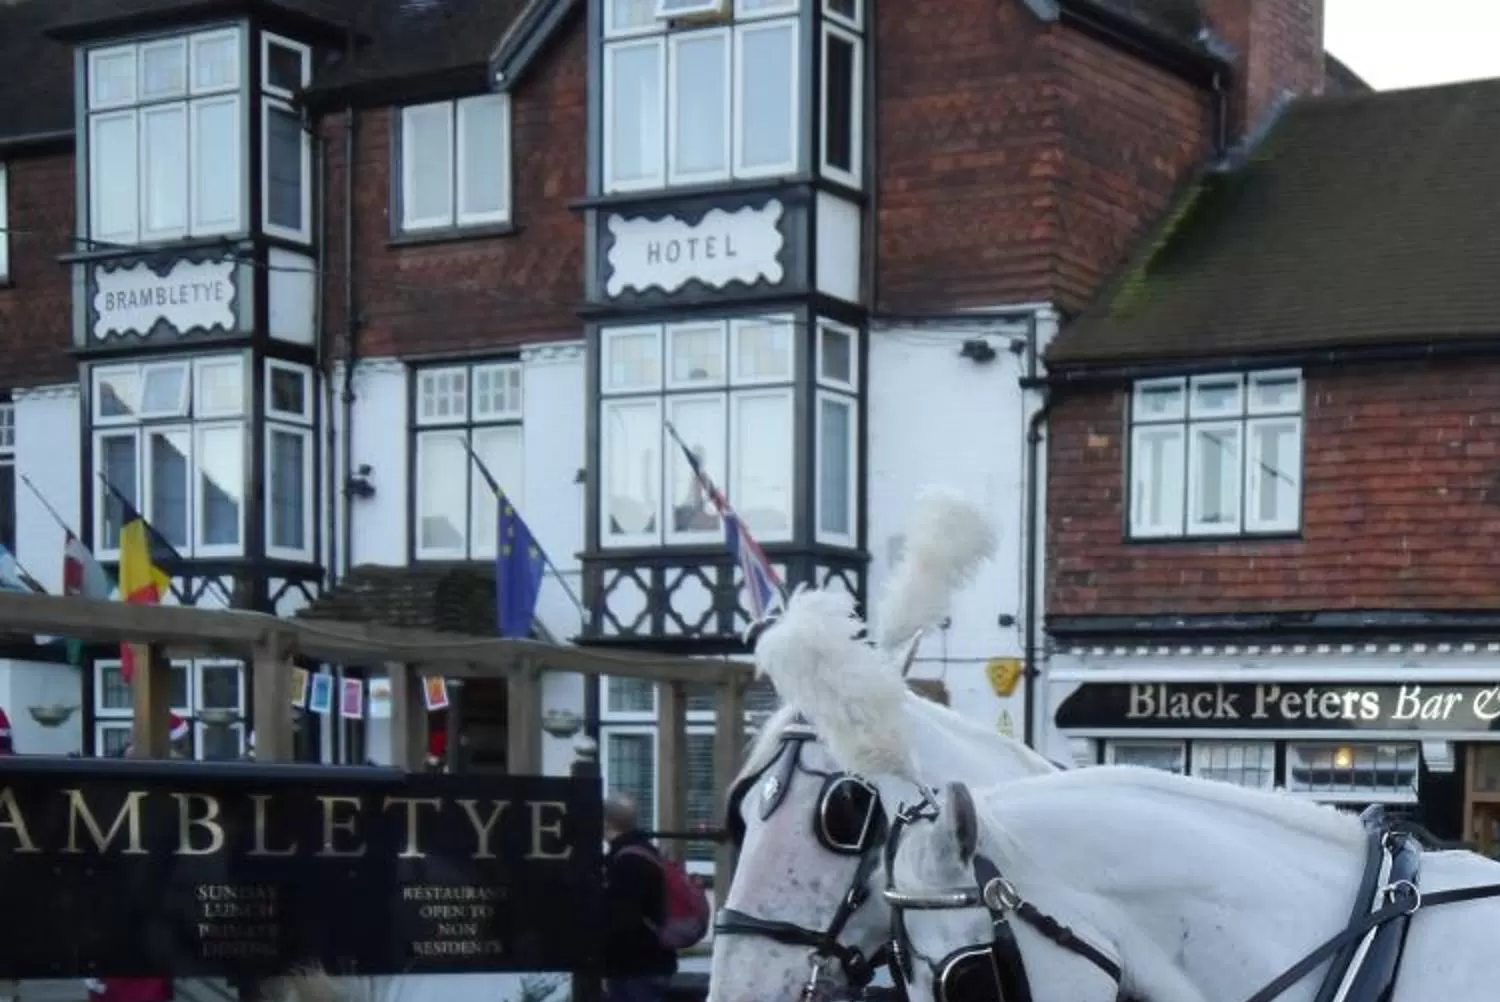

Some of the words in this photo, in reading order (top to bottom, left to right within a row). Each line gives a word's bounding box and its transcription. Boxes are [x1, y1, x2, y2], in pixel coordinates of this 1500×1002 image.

[646, 232, 737, 266] HOTEL
[105, 280, 224, 312] BRAMBLETYE
[1126, 683, 1241, 720] Black
[1251, 683, 1381, 720] Peters
[1391, 684, 1463, 721] Bar
[419, 904, 465, 919] OPEN
[470, 904, 495, 918] TO
[438, 923, 479, 937] NON
